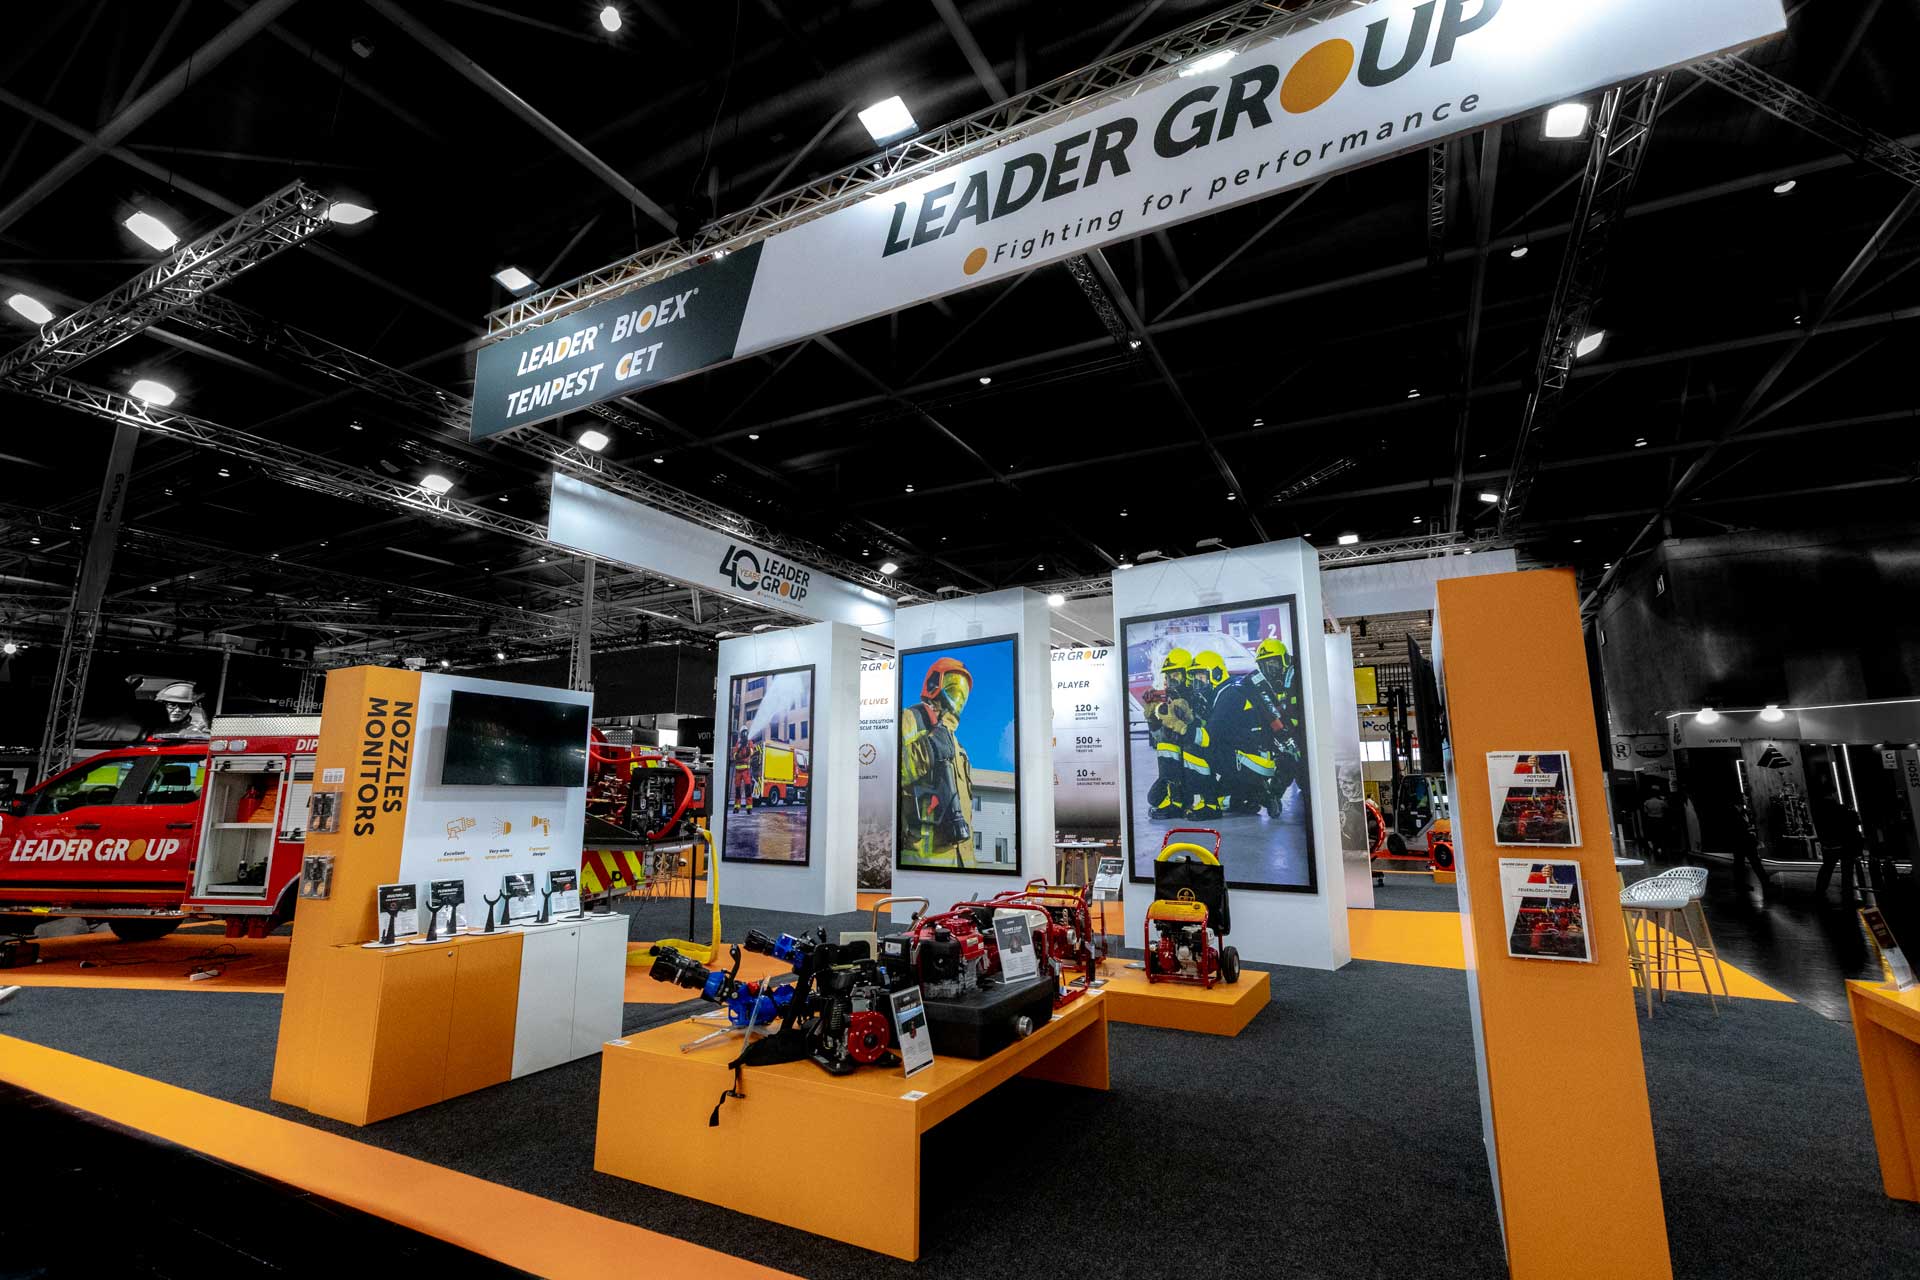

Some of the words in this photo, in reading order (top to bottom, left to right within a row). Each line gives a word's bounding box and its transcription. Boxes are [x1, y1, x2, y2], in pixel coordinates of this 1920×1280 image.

[882, 116, 1138, 257] LEADER
[1152, 0, 1502, 158] GROUP
[993, 209, 1124, 265] Fighting
[1142, 186, 1193, 216] for
[1209, 94, 1480, 200] performance
[506, 362, 604, 419] TEMPEST
[615, 342, 664, 382] CET
[720, 544, 761, 592] 40
[763, 556, 810, 588] LEADER
[761, 575, 808, 602] GROUP
[1267, 624, 1278, 640] 2
[1067, 649, 1108, 660] GROUP
[1057, 681, 1090, 689] PLAYER
[869, 697, 889, 705] LIVES
[1075, 704, 1092, 712] 120
[1076, 736, 1093, 744] 500
[353, 697, 389, 836] MONITORS
[382, 701, 414, 813] NOZZLES
[1077, 769, 1088, 777] 10
[1906, 760, 1920, 787] HOSES
[9, 838, 93, 862] LEADER
[94, 838, 180, 862] GROUP
